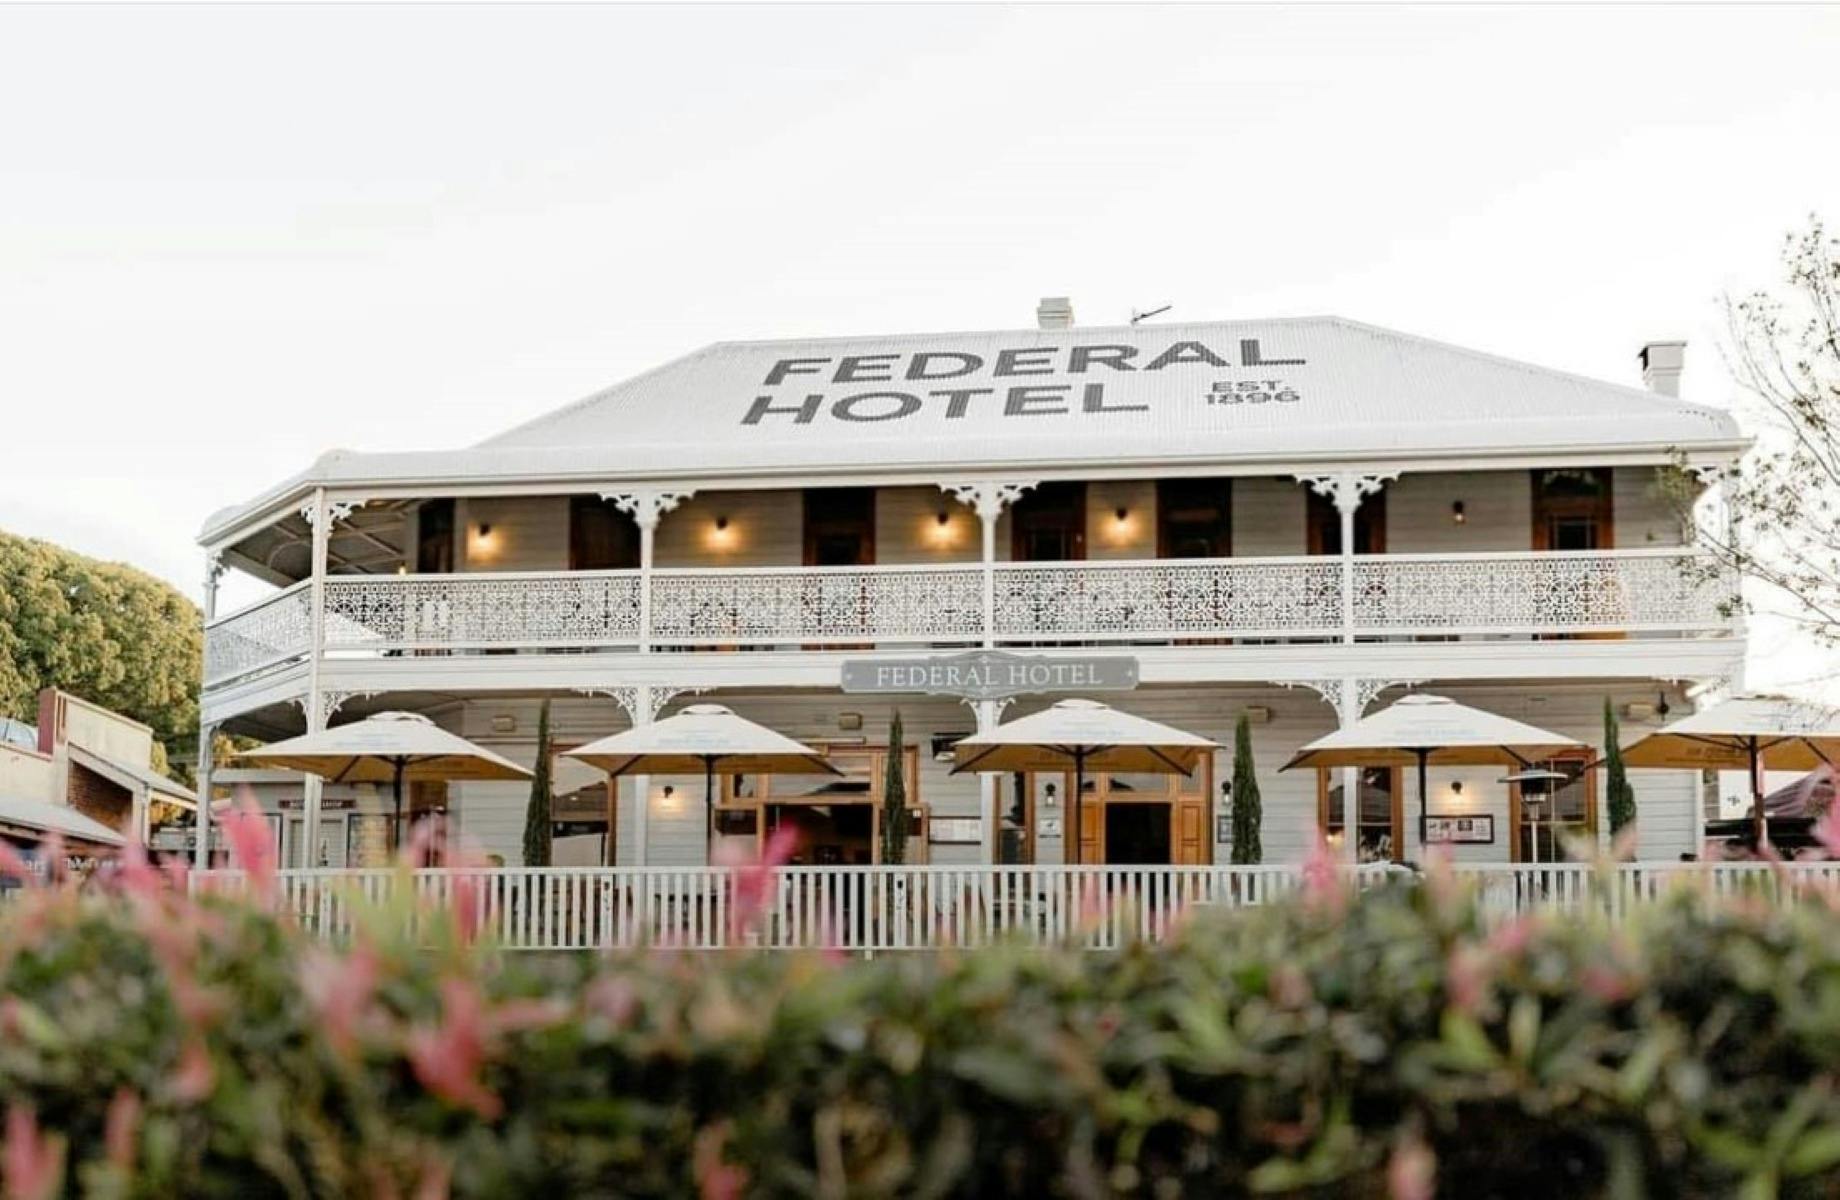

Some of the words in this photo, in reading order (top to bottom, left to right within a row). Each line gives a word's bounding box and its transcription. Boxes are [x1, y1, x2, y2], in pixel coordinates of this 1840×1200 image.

[762, 338, 1307, 386] FEDERAL
[1212, 380, 1292, 392] EST.
[740, 383, 1149, 425] HOTEL
[1203, 391, 1301, 405] 1896
[877, 665, 999, 687] FEDERAL
[1008, 664, 1103, 685] HOTEL
